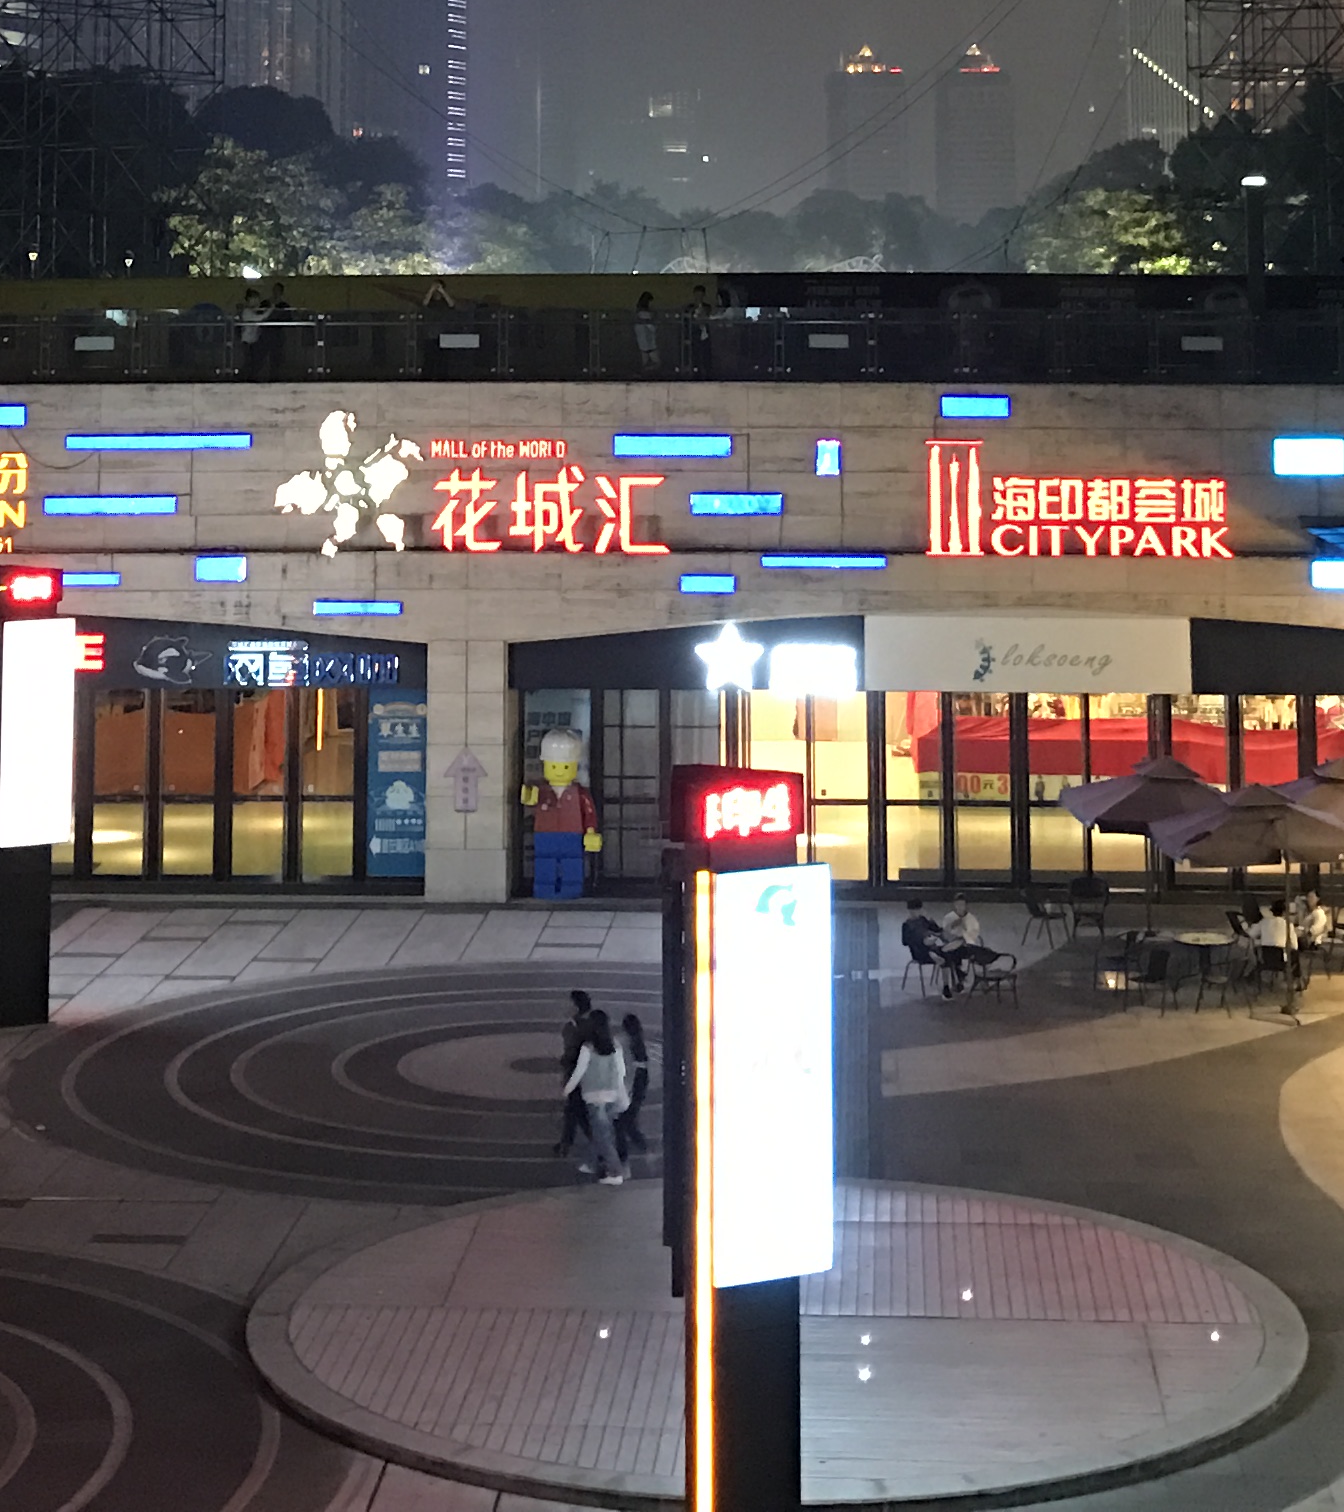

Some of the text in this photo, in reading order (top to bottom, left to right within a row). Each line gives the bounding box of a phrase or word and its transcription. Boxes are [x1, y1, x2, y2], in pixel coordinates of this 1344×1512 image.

[430, 439, 468, 458] MALL
[471, 439, 488, 458] of
[490, 440, 515, 458] the
[431, 465, 671, 555] 花城汇
[990, 476, 1226, 523] 海印都荟城
[990, 524, 1234, 559] CITYPARK
